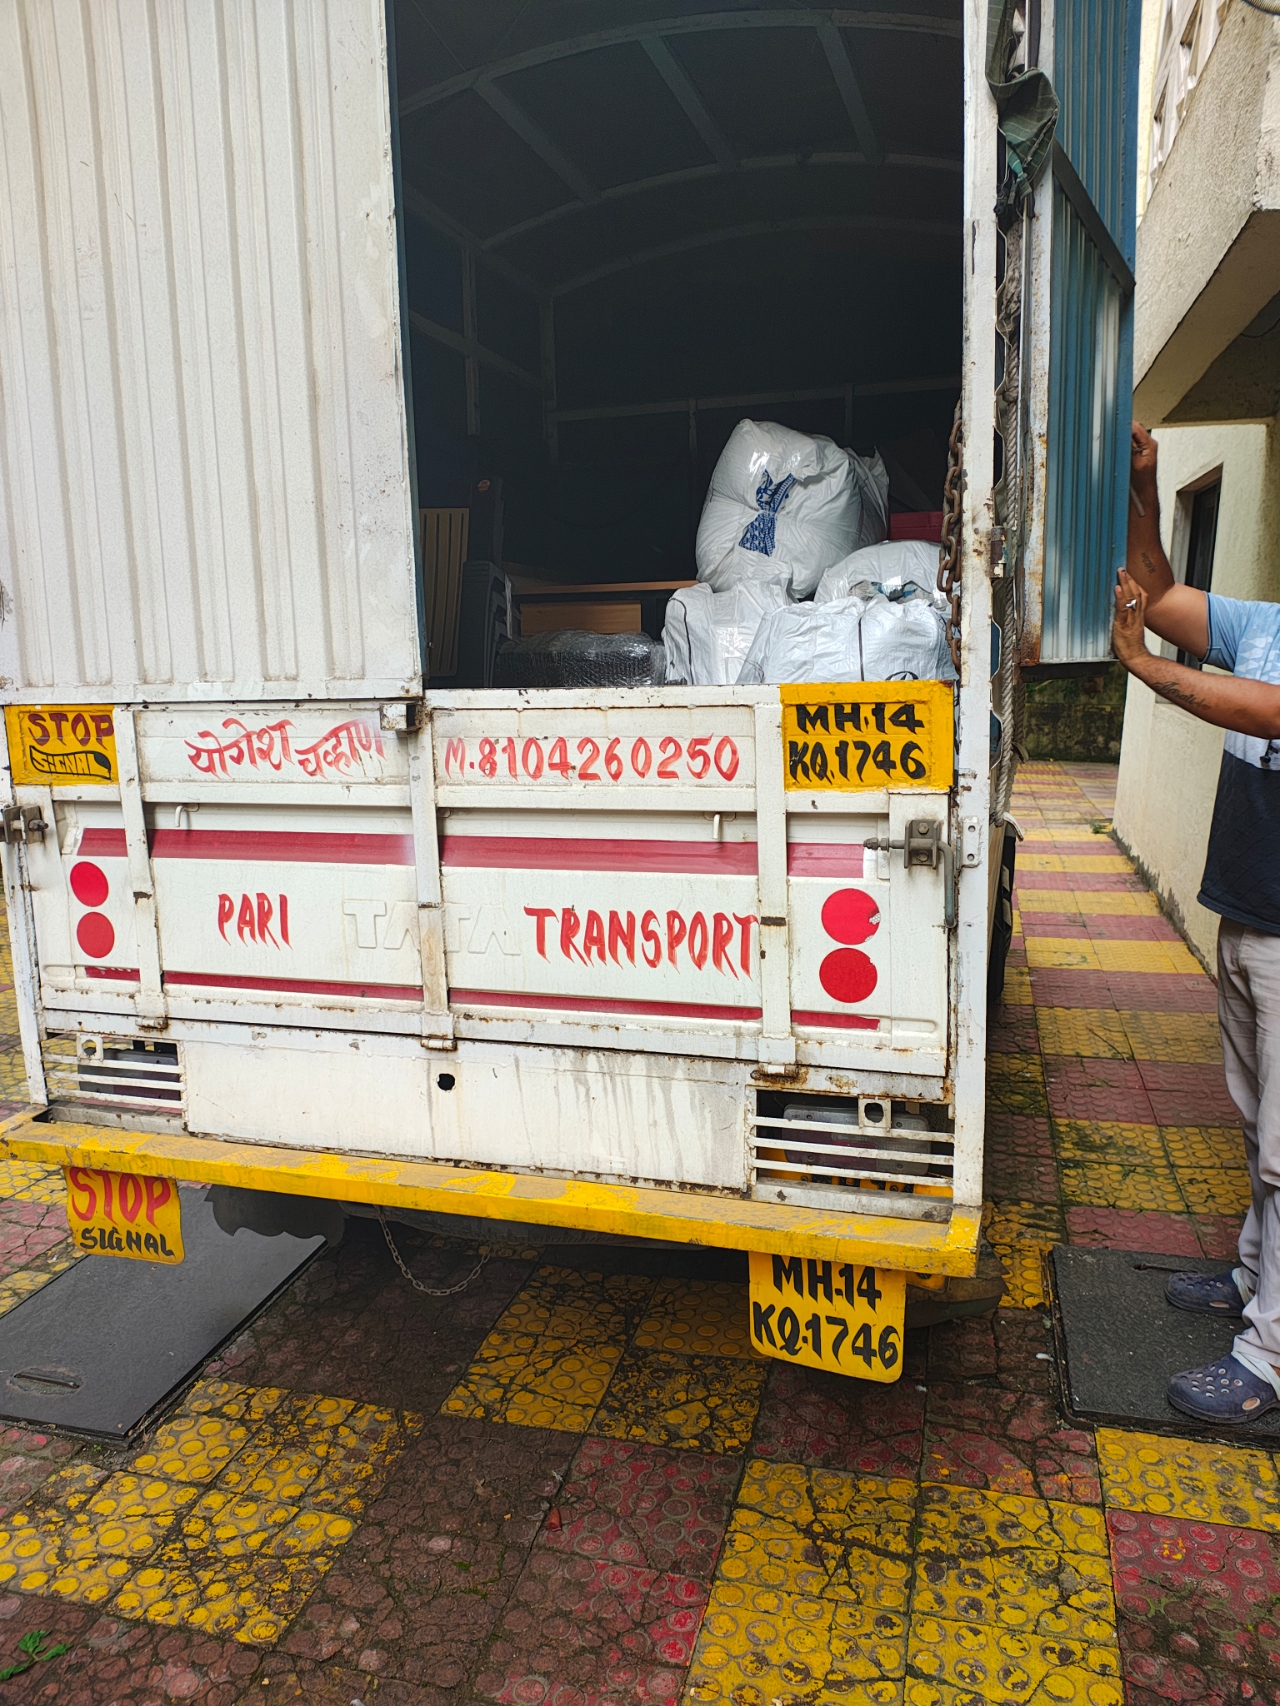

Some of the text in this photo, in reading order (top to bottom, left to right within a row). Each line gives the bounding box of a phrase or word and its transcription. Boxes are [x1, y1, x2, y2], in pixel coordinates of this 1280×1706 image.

[27, 712, 114, 751] STOP
[184, 718, 387, 780] योगेश चव्हाण
[796, 702, 926, 736] MH.14
[788, 740, 927, 785] KQ.1746
[217, 892, 760, 982] PARI TRANSPORT
[69, 1166, 171, 1230] STOP
[80, 1226, 176, 1259] SIGNAL
[772, 1253, 882, 1315] MH.14
[752, 1300, 901, 1372] KQ.1746
